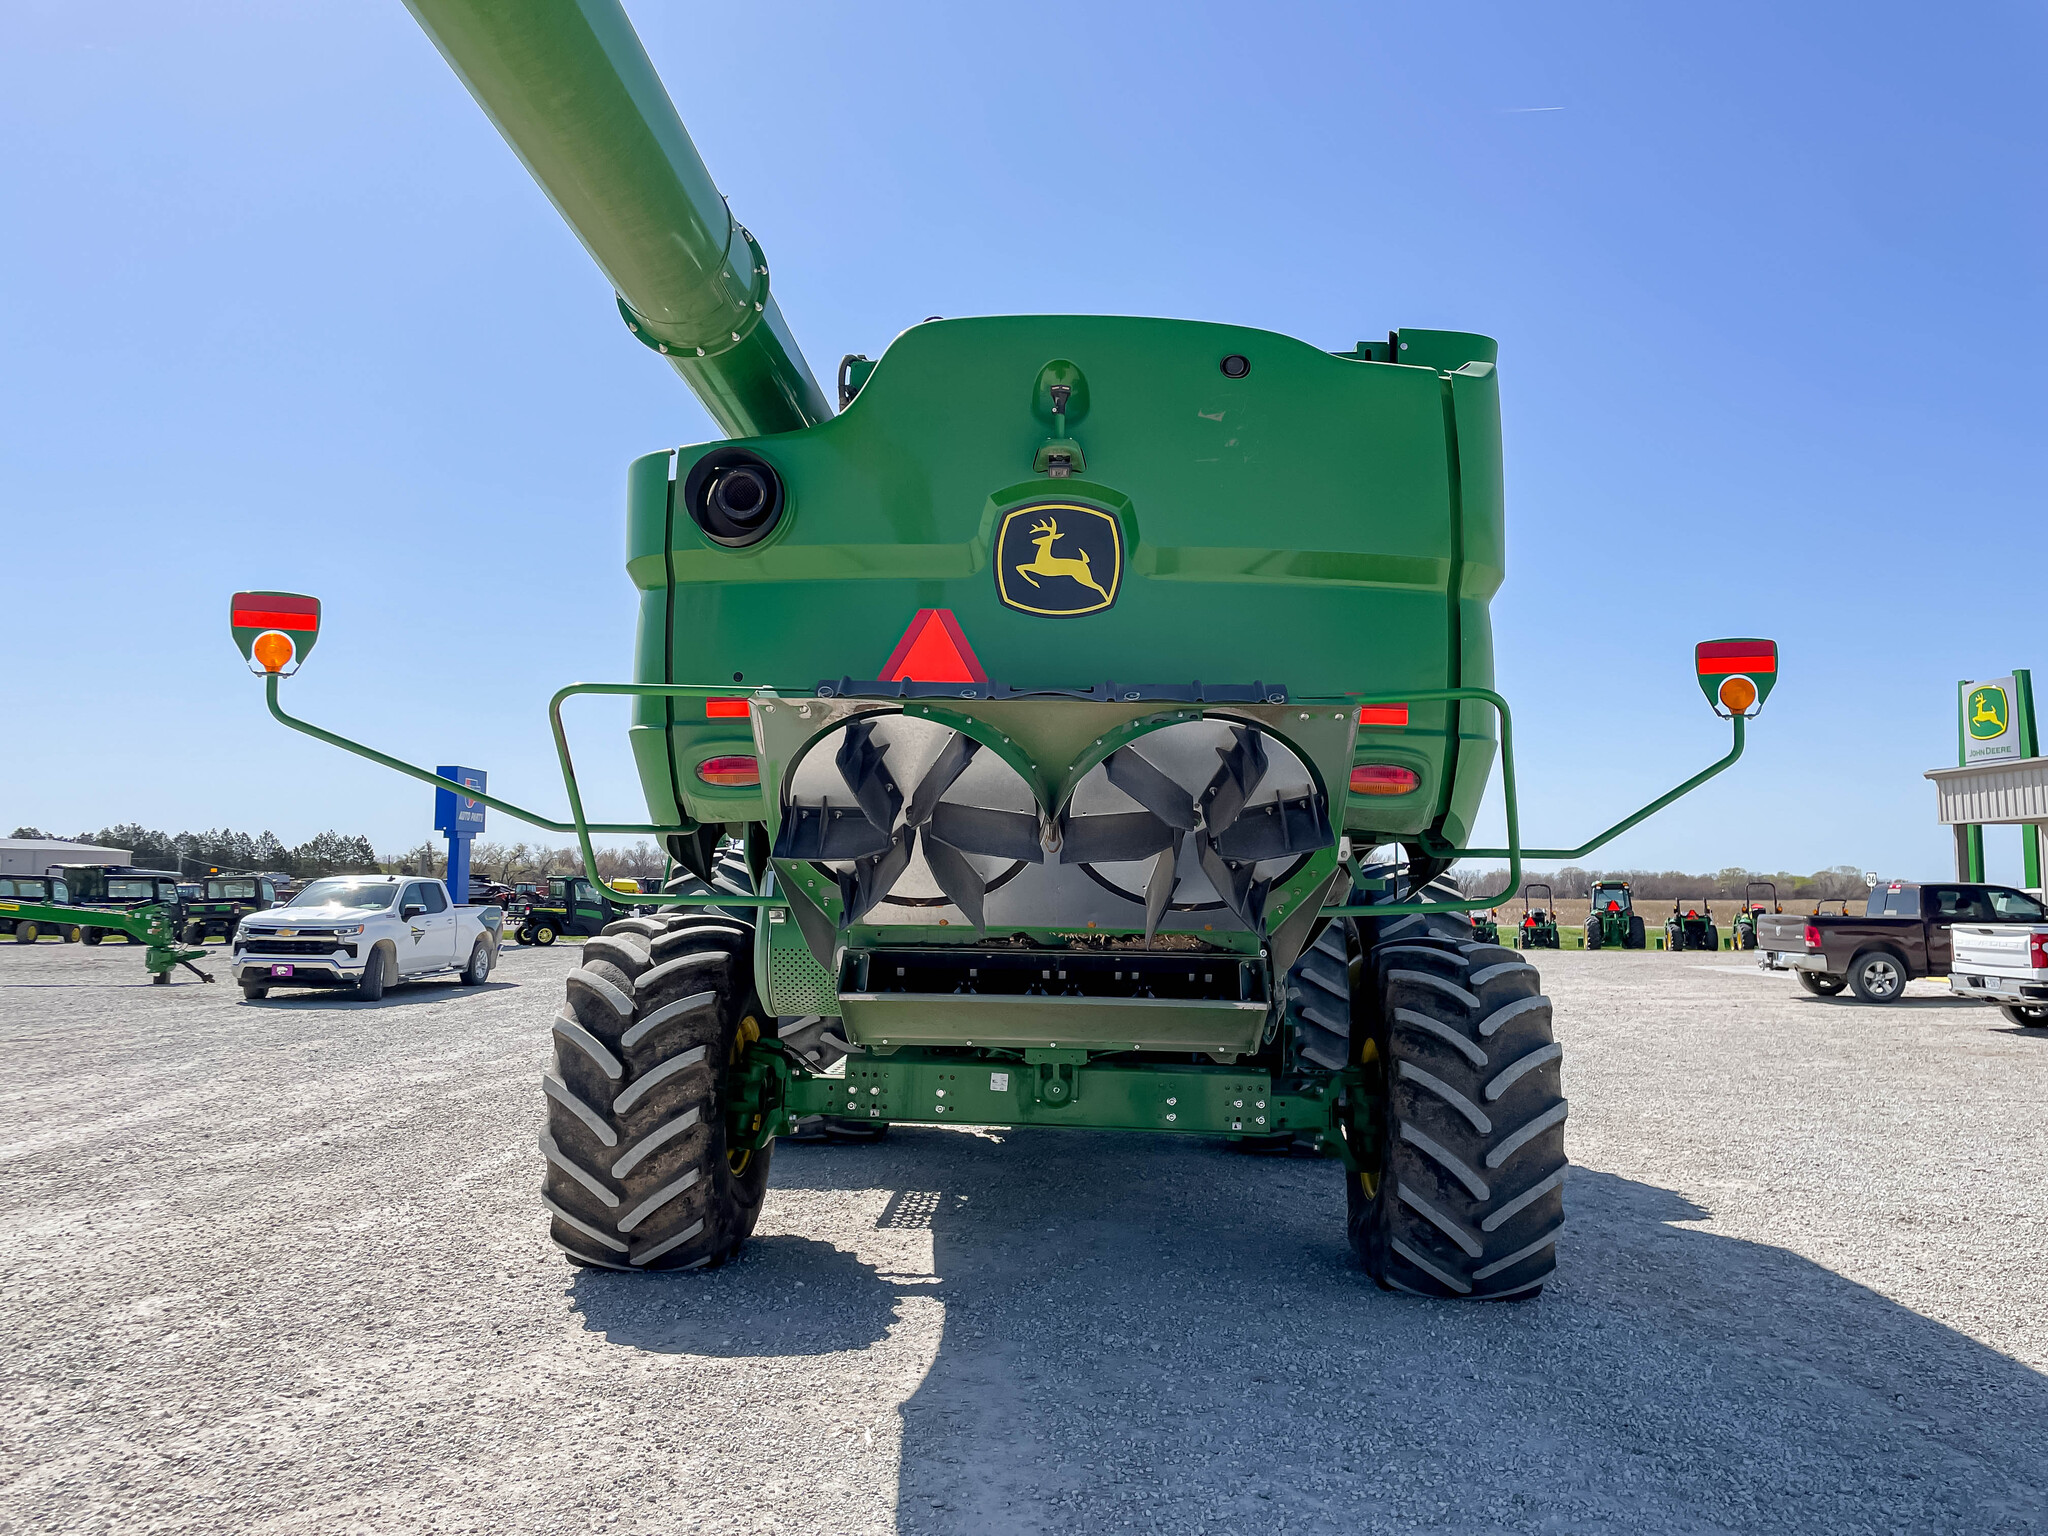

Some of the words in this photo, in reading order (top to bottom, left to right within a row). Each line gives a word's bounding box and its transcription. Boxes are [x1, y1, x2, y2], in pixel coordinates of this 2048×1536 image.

[1969, 748, 1985, 757] JOHN
[1986, 746, 2011, 755] DEERE
[1868, 875, 1875, 884] 36
